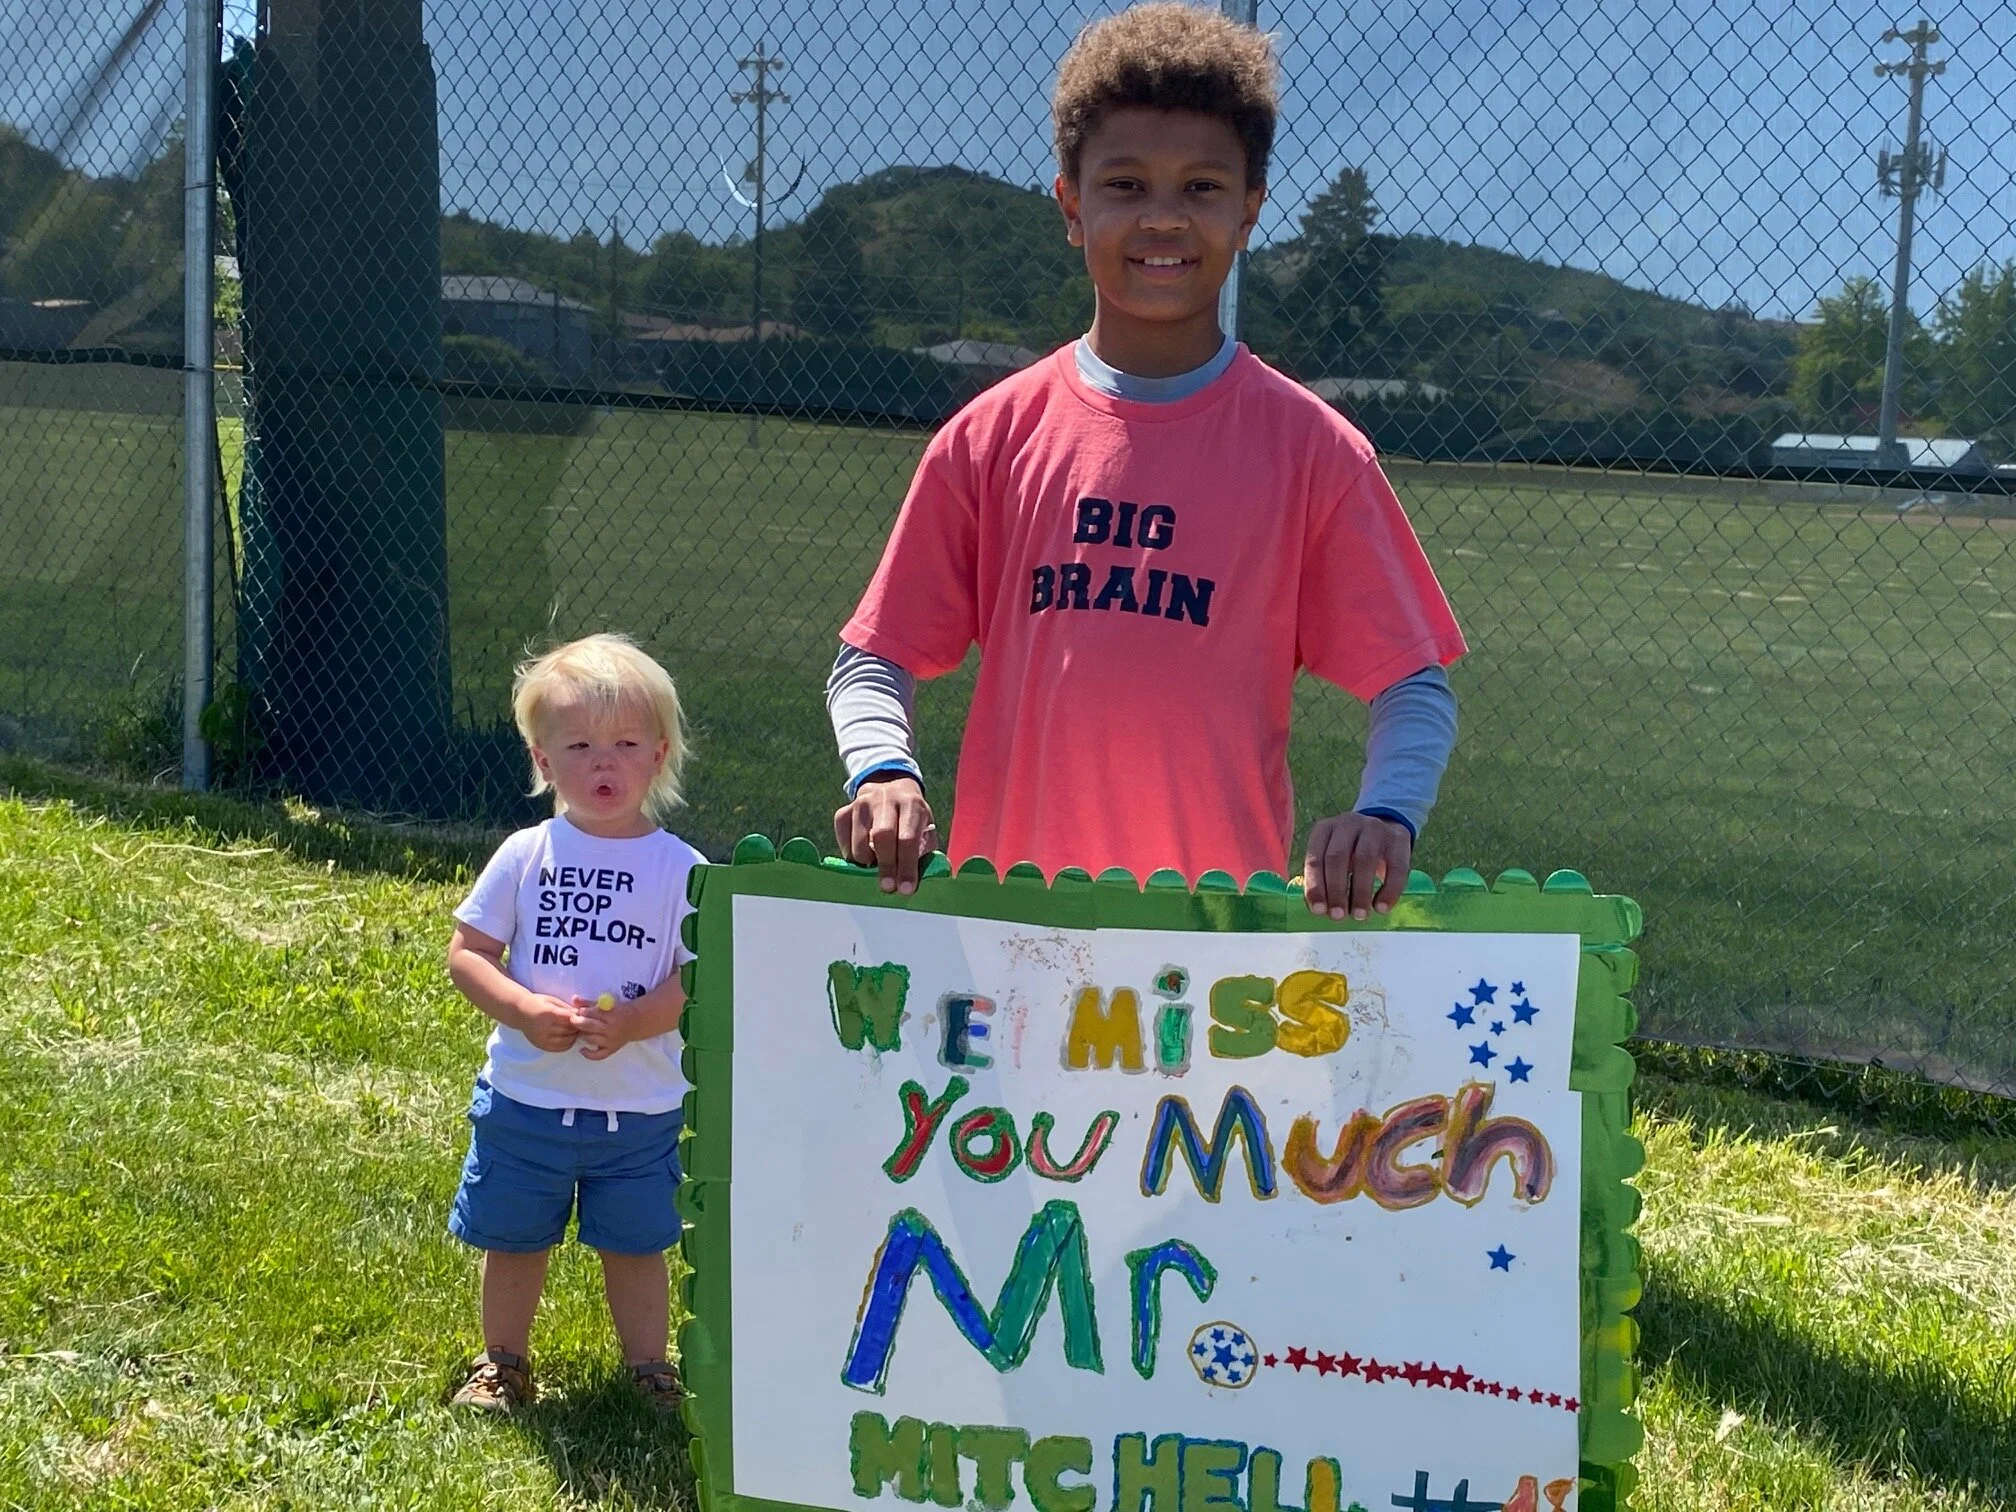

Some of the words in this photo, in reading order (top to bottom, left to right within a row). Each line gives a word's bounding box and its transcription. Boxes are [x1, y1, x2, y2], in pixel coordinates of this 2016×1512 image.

[1073, 497, 1176, 550] BIG
[1030, 563, 1215, 627] BRAIN
[540, 867, 634, 892] NEVER
[540, 891, 612, 915] STOP
[536, 916, 656, 949] EXPLOR-
[533, 944, 578, 966] ING
[828, 959, 997, 1074] WE
[1140, 1080, 1556, 1211] Much
